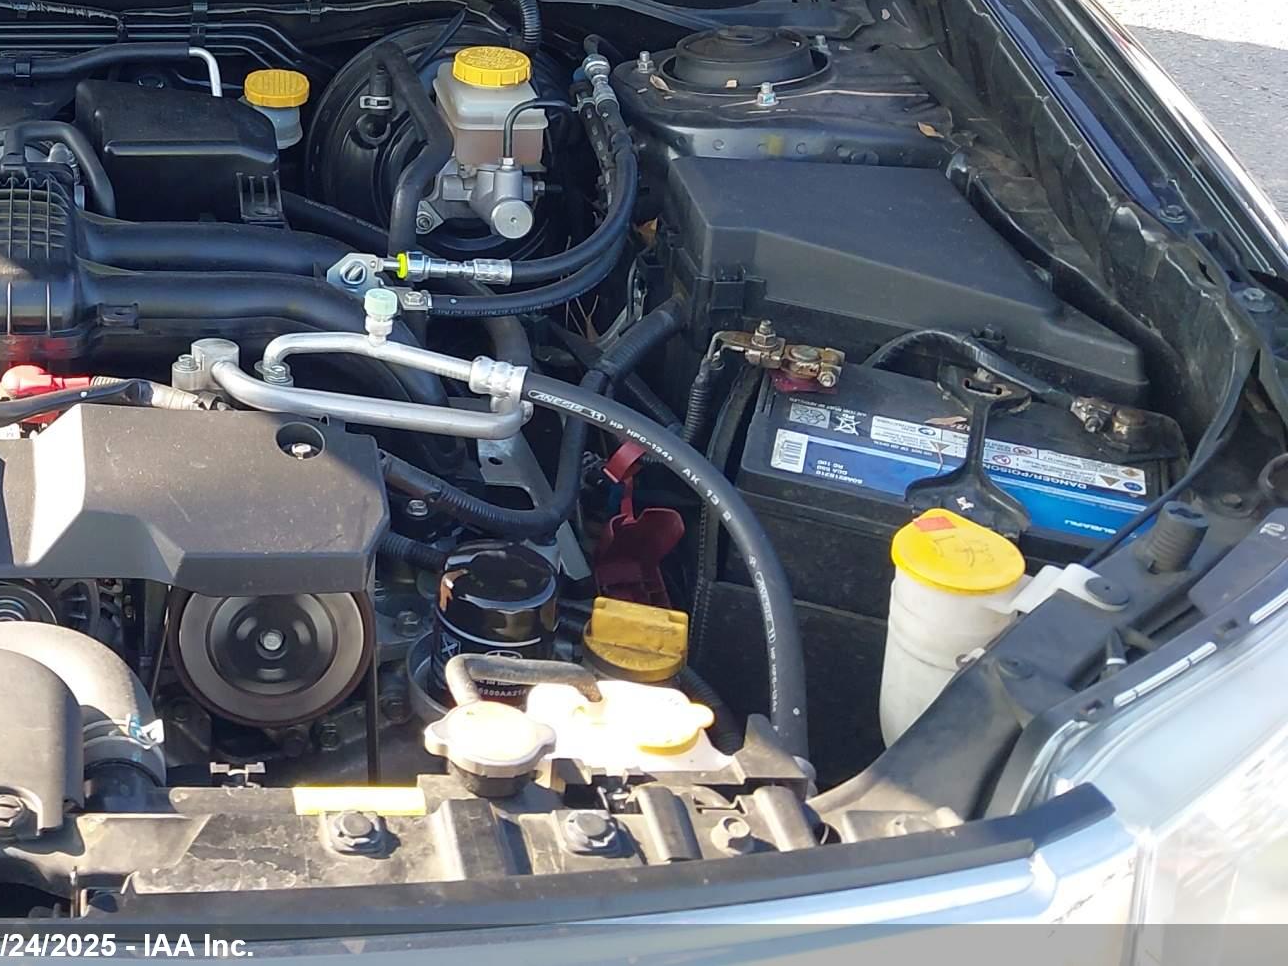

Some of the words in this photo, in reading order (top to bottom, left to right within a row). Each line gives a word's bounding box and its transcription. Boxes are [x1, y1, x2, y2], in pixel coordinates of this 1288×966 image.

[609, 420, 624, 430] HP
[682, 468, 701, 485] AK
[982, 464, 1087, 490] DANGER/POISON
[1064, 519, 1117, 534] SUBARU
